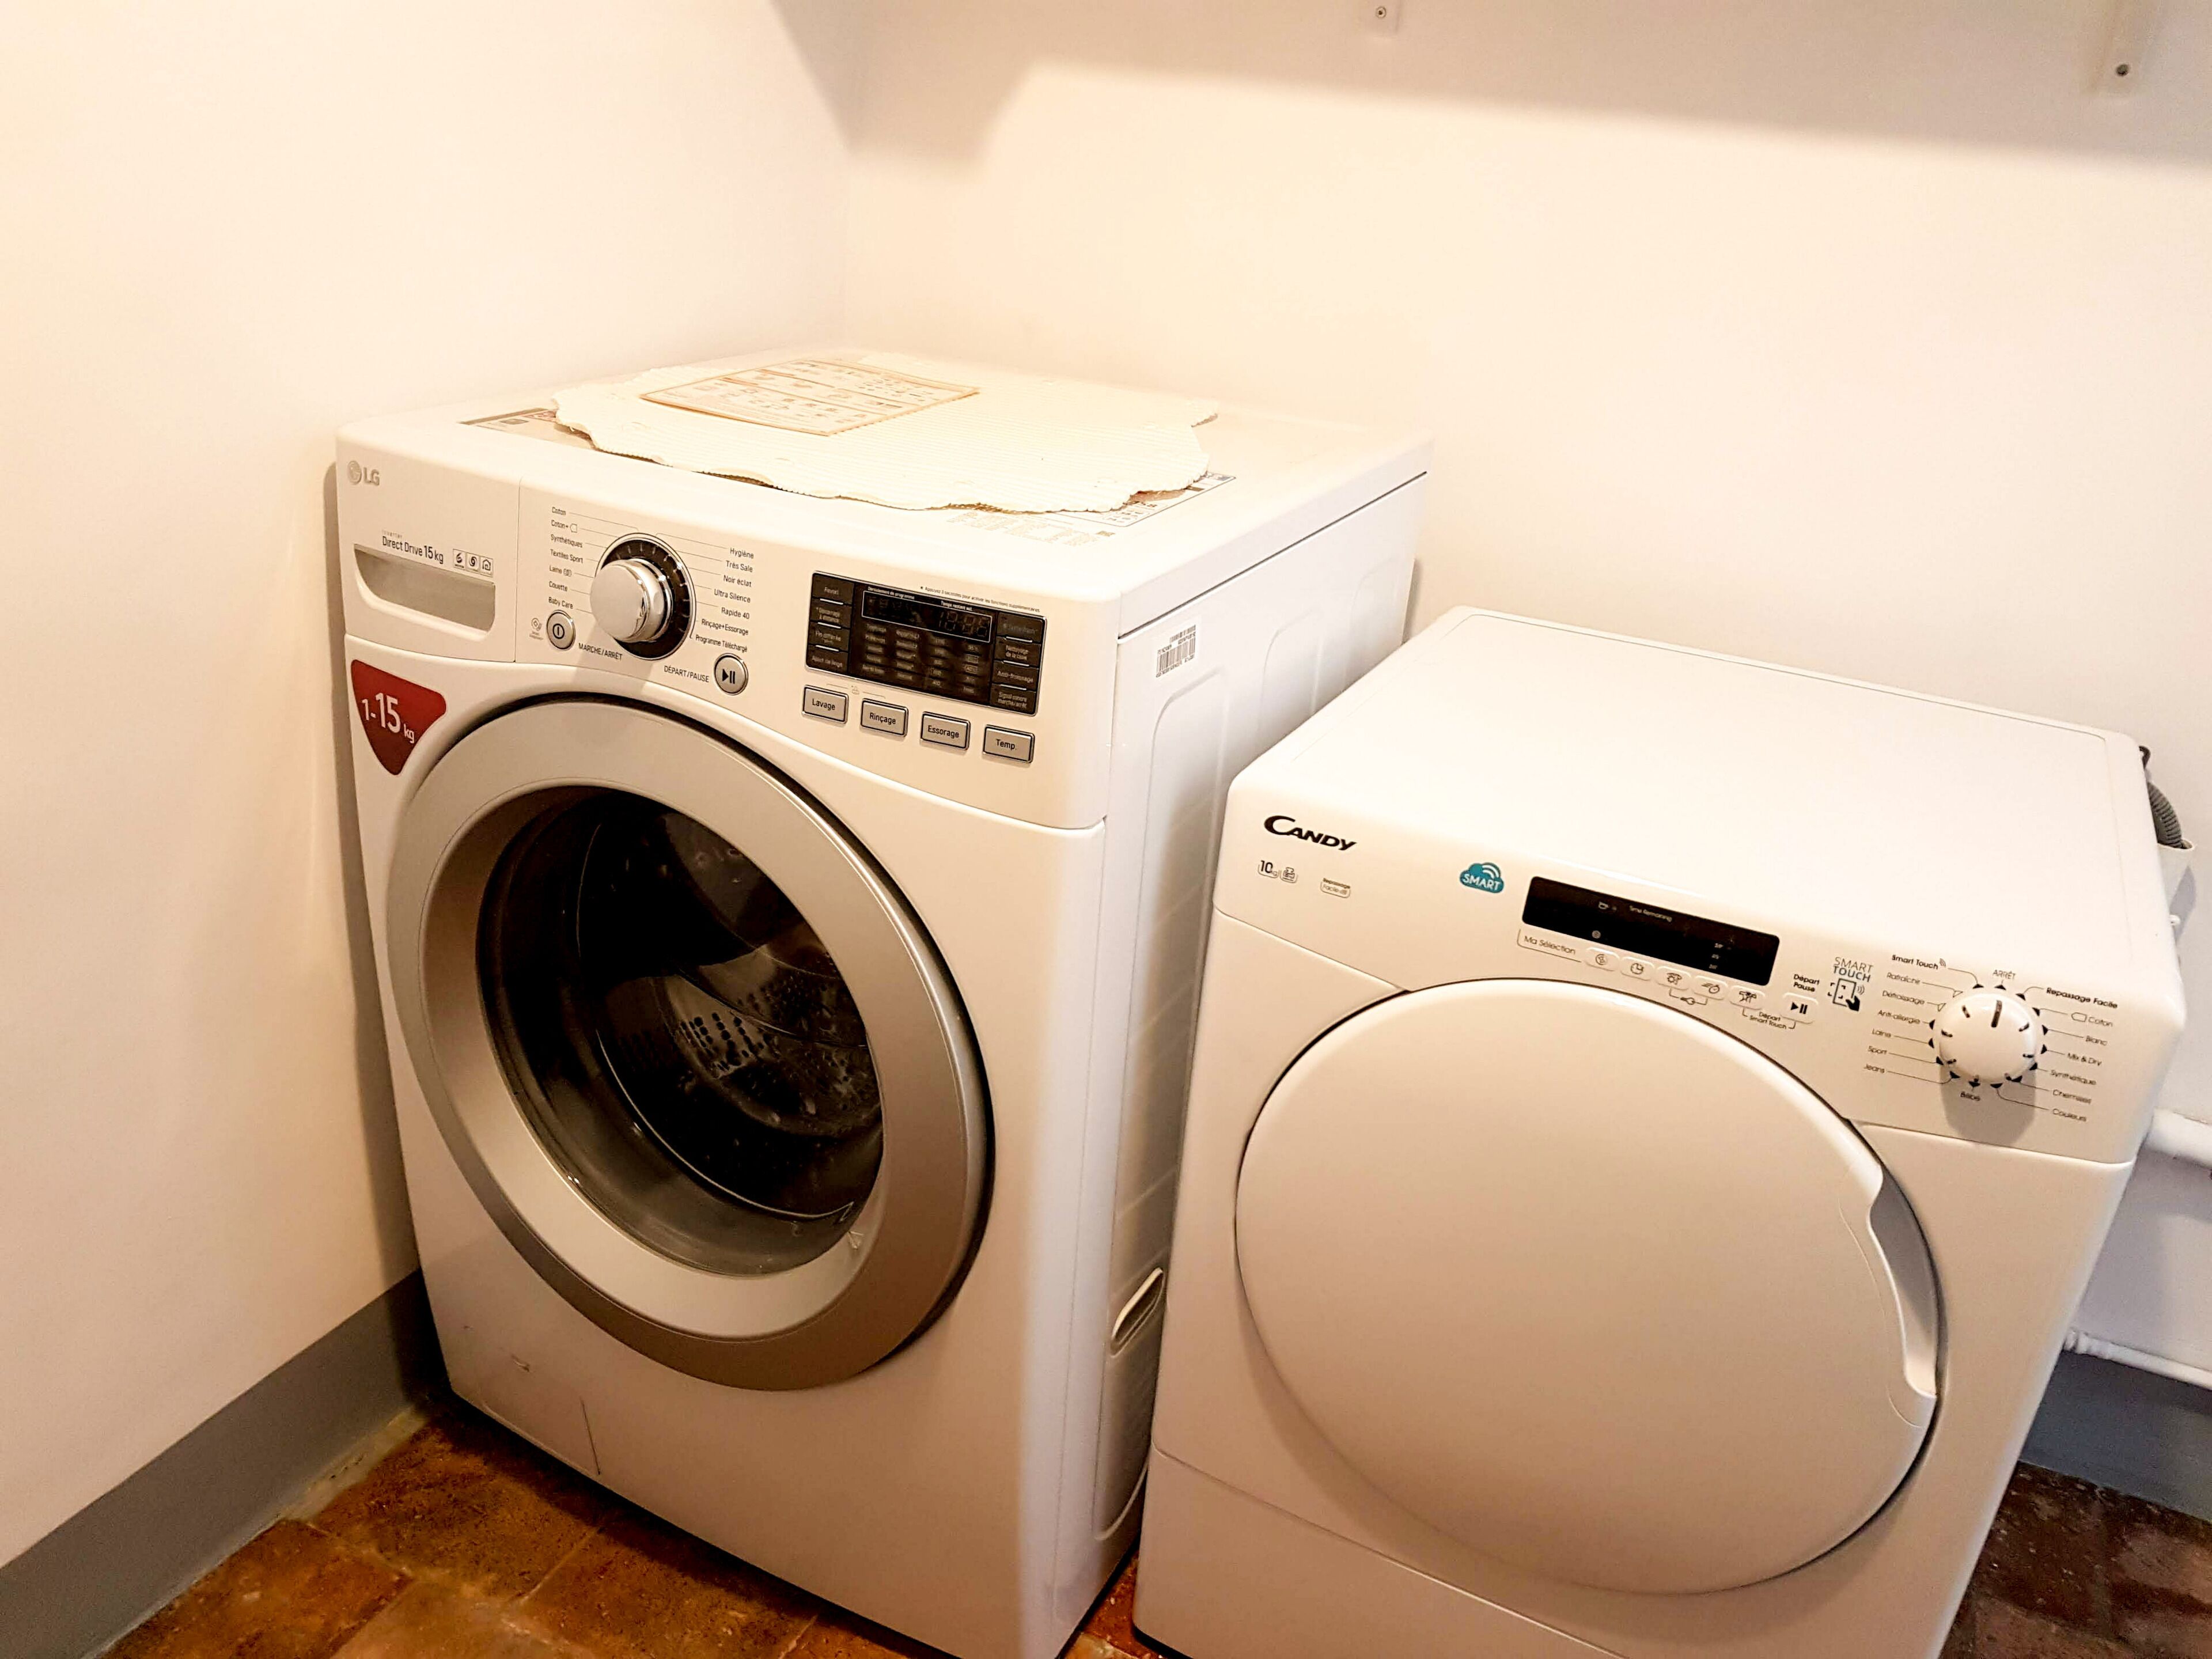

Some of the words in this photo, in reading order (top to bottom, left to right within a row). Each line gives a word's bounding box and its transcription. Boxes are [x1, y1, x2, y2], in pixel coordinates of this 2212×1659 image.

[363, 467, 380, 486] LG
[552, 506, 566, 516] Coton
[551, 533, 582, 548] Synthétiques
[382, 536, 403, 551] Direct
[404, 542, 423, 556] Drive
[424, 545, 433, 559] 15
[434, 550, 444, 565] kg
[550, 548, 569, 559] Textiles
[570, 554, 583, 563] Sport
[729, 547, 754, 559] Hygiène
[549, 565, 562, 574] Laine
[726, 560, 738, 569] Très
[740, 563, 753, 573] Sale
[549, 581, 568, 592] Couette
[724, 575, 736, 584] Noir
[548, 597, 560, 607] Baby
[562, 600, 573, 609] Care
[714, 589, 728, 598] Ultra
[729, 592, 751, 603] Silence
[721, 607, 741, 618] Rapide
[695, 634, 721, 646] Programme
[722, 640, 748, 653] Téléchargé
[578, 642, 623, 661] MARCHE/ARRÊT
[664, 665, 710, 683] DÉPART/PAUSE
[812, 698, 835, 711] Lavage
[869, 712, 896, 726] Rinçage
[404, 724, 415, 744] kg
[927, 725, 959, 739] Essorage
[996, 738, 1017, 751] Temp.
[1260, 860, 1273, 873] 10
[1463, 873, 1501, 892] SMART
[1524, 935, 1537, 945] Ma
[1539, 939, 1576, 955] Sélection
[1834, 956, 1874, 974] SMART
[1892, 954, 1914, 965] Smart
[1916, 959, 1938, 970] Touch
[1793, 974, 1820, 986] Départ
[1834, 965, 1871, 983] TOUCH
[1793, 982, 1816, 992] Pause
[2046, 987, 2091, 1003] Repassage
[2093, 997, 2118, 1009] Facile
[1749, 1015, 1768, 1024] Smart
[1769, 1020, 1787, 1029] Touch
[1759, 1011, 1781, 1022] Départ
[2088, 1016, 2113, 1028] Coton
[1872, 1028, 1891, 1037] Laine
[2085, 1035, 2108, 1046] Blanc
[1868, 1046, 1888, 1055] Sport
[2067, 1052, 2080, 1062] Mix
[2088, 1057, 2102, 1067] Dry
[1863, 1063, 1885, 1073] Jeans
[2052, 1108, 2087, 1123] Couleurs
